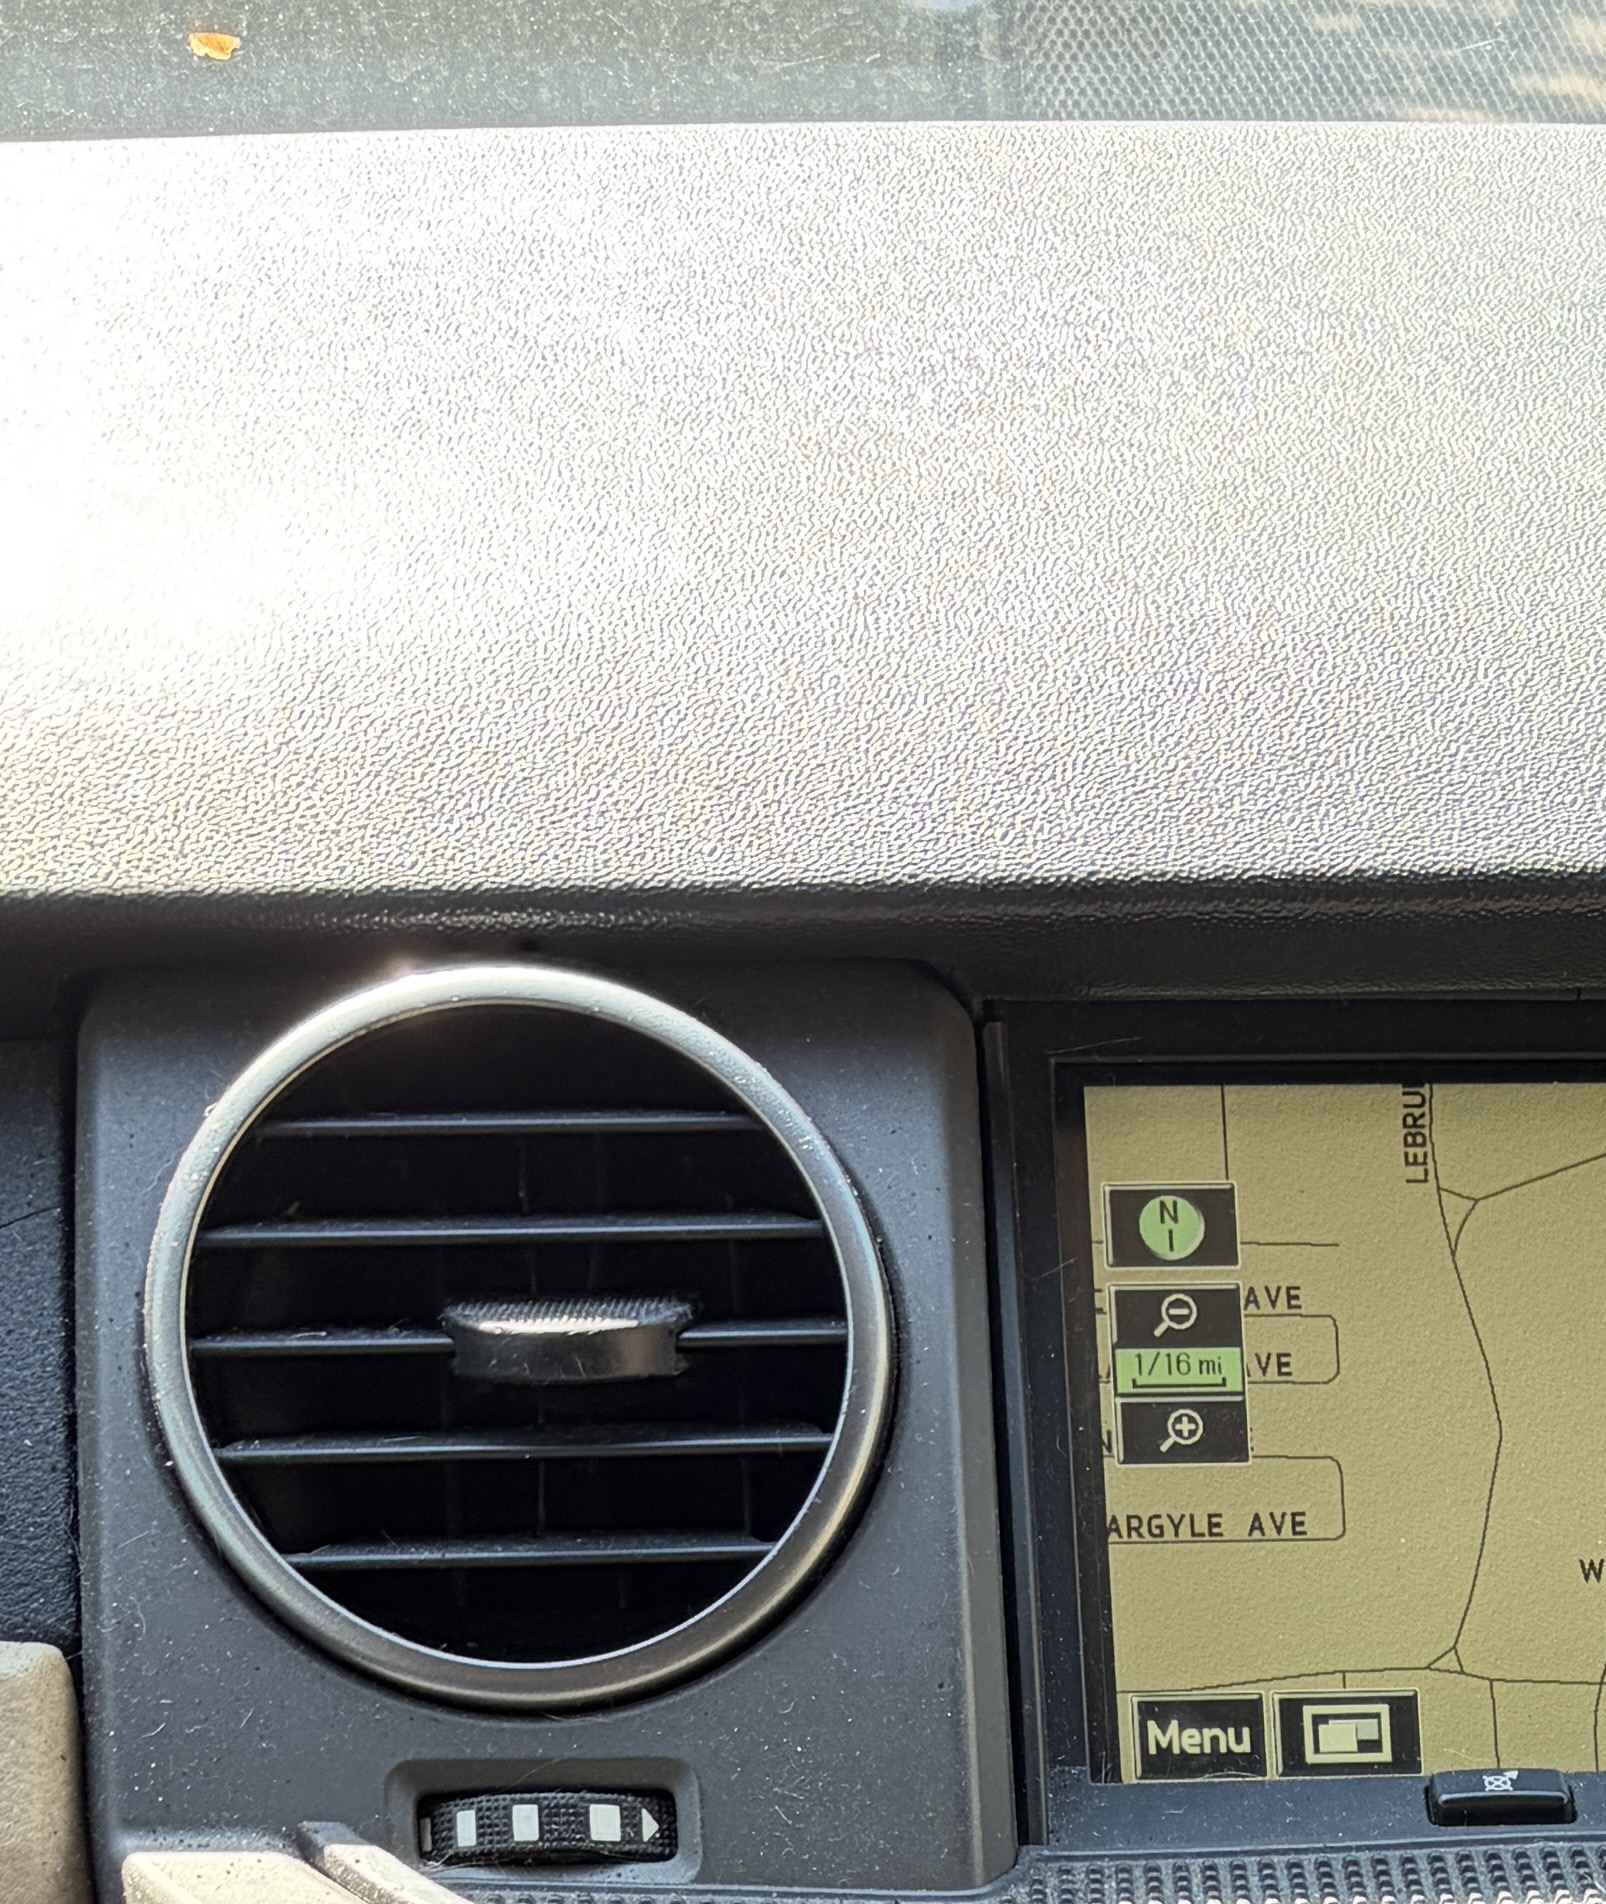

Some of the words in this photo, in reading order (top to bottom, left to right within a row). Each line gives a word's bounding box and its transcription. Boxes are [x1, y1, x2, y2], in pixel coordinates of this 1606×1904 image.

[1402, 1084, 1429, 1183] LEBRU
[1244, 1286, 1302, 1310] AVE
[1135, 1352, 1191, 1376] 1/16
[1199, 1356, 1223, 1376] mi
[1107, 1513, 1224, 1538] ARGYLE
[1248, 1512, 1307, 1536] AVE
[1147, 1720, 1251, 1755] Menu
